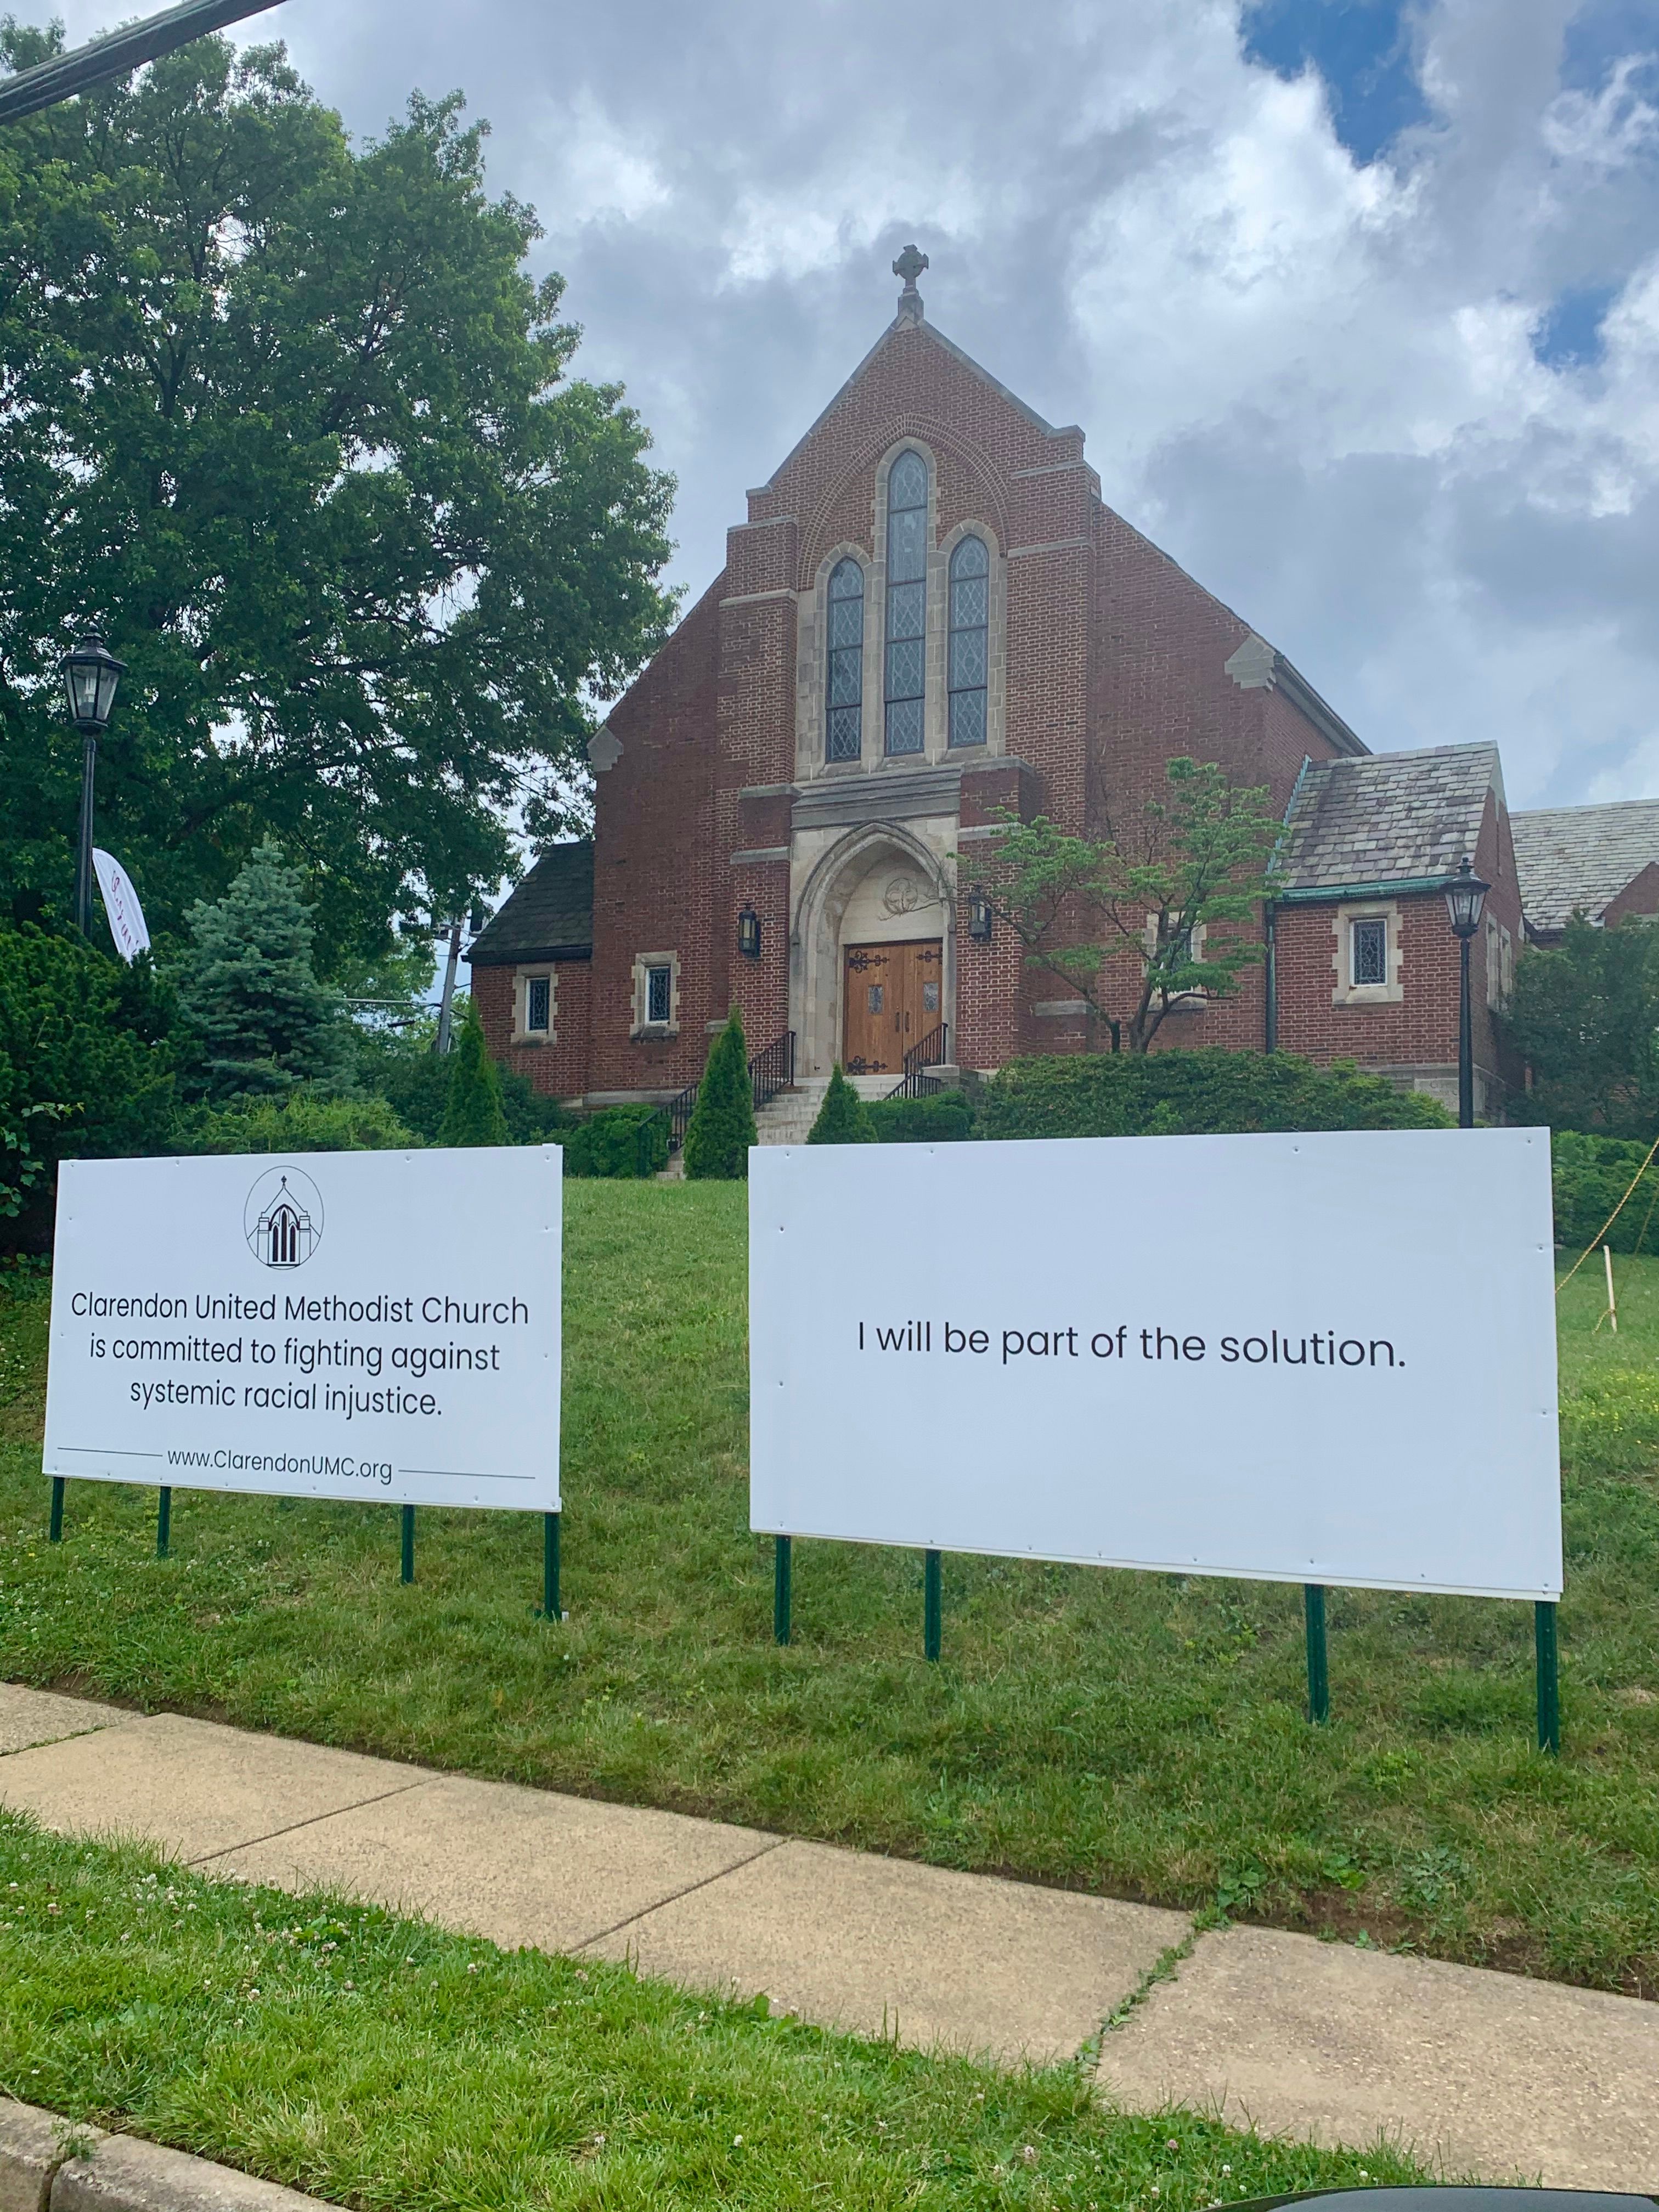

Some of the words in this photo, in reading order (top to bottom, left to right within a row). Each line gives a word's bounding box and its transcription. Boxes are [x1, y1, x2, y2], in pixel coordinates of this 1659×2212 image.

[72, 1292, 187, 1318] Clarendon
[196, 1294, 276, 1321] United
[285, 1295, 414, 1323] Methodist
[422, 1296, 528, 1324] Church
[90, 1332, 106, 1358] is
[112, 1338, 242, 1363] committed
[251, 1339, 276, 1364] to
[284, 1338, 382, 1376] fighting
[391, 1341, 500, 1378] against
[859, 1321, 864, 1350] I
[876, 1319, 930, 1352] will
[945, 1321, 990, 1354] be
[1002, 1327, 1079, 1365] part
[1091, 1325, 1127, 1358] of
[1139, 1327, 1206, 1362] the
[1220, 1329, 1406, 1367] solution.
[130, 1379, 236, 1410] systemic
[244, 1383, 317, 1410] racial
[325, 1383, 442, 1421] injustice.
[167, 1449, 392, 1486] www.ClarendonUMC.org
